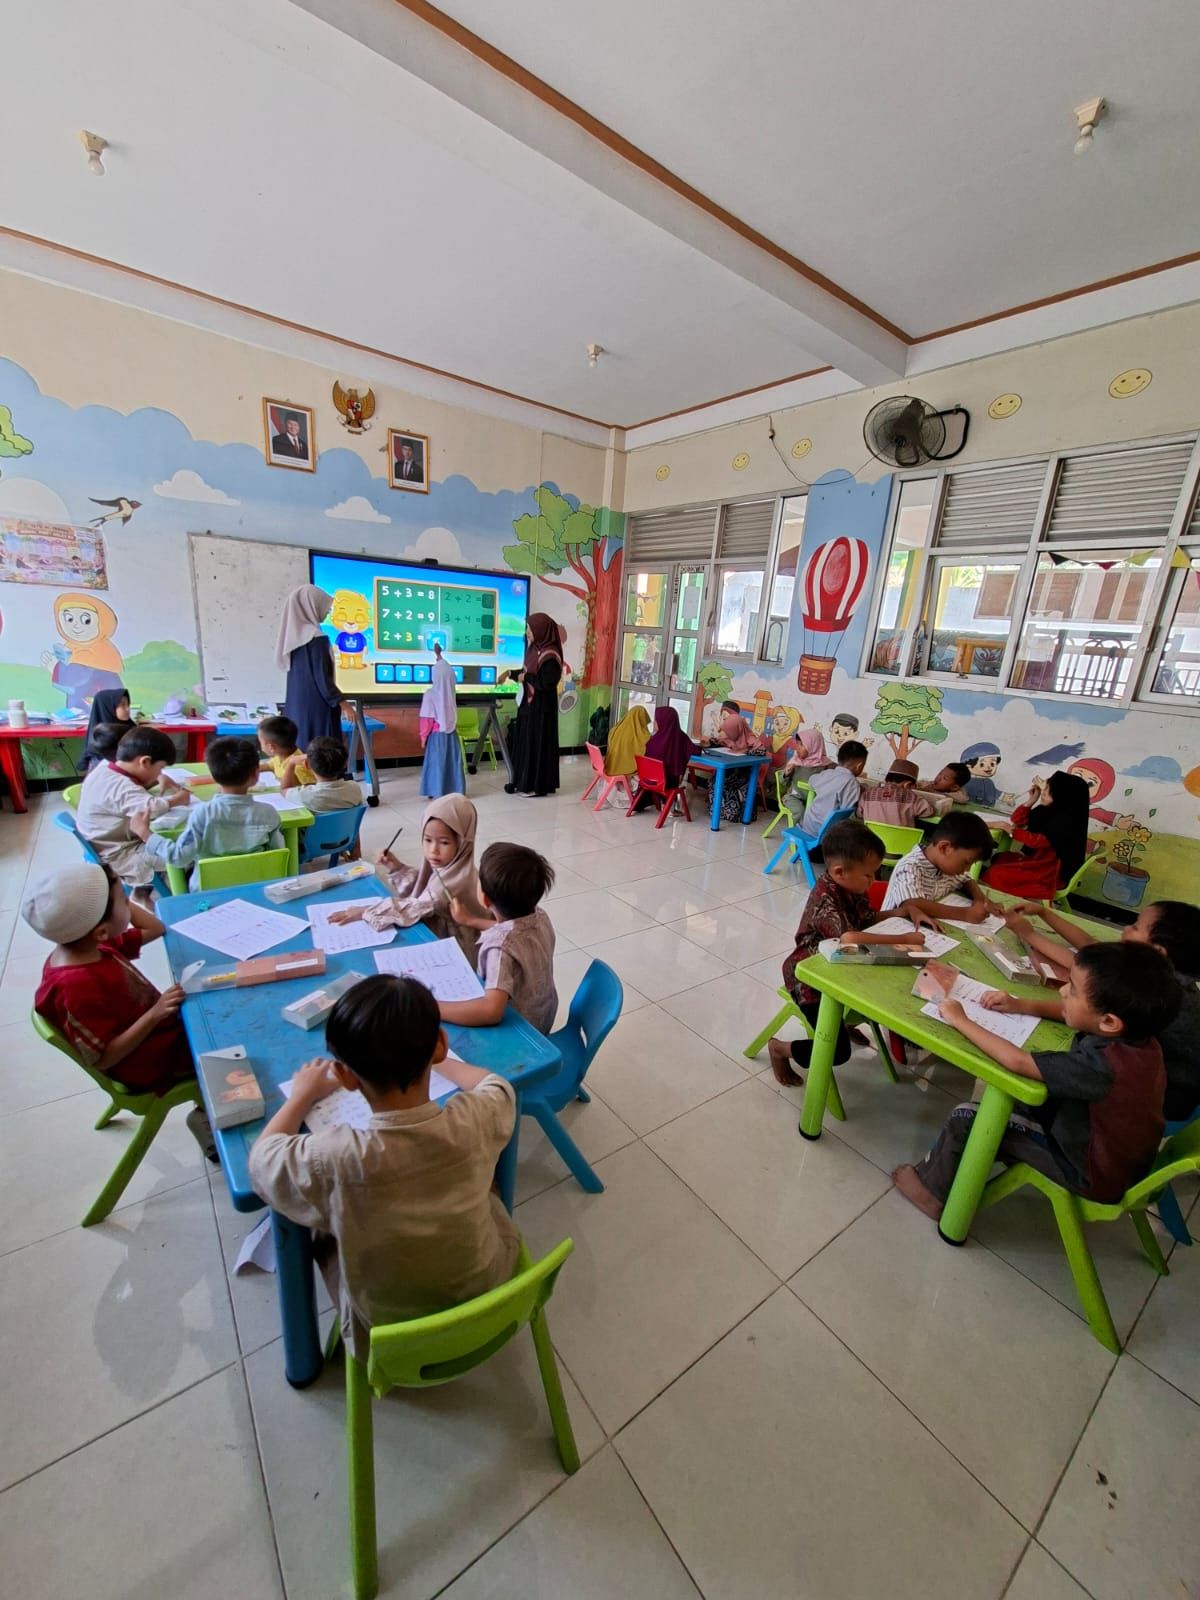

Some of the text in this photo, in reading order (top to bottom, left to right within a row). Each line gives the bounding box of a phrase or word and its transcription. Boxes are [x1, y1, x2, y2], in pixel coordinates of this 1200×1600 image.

[381, 585, 390, 596] 5
[405, 587, 413, 598] 3
[428, 590, 435, 600] 8
[382, 608, 390, 618] 7
[405, 610, 413, 620] 2
[428, 612, 435, 622] 9
[383, 631, 390, 641] 2
[405, 632, 413, 642] 3
